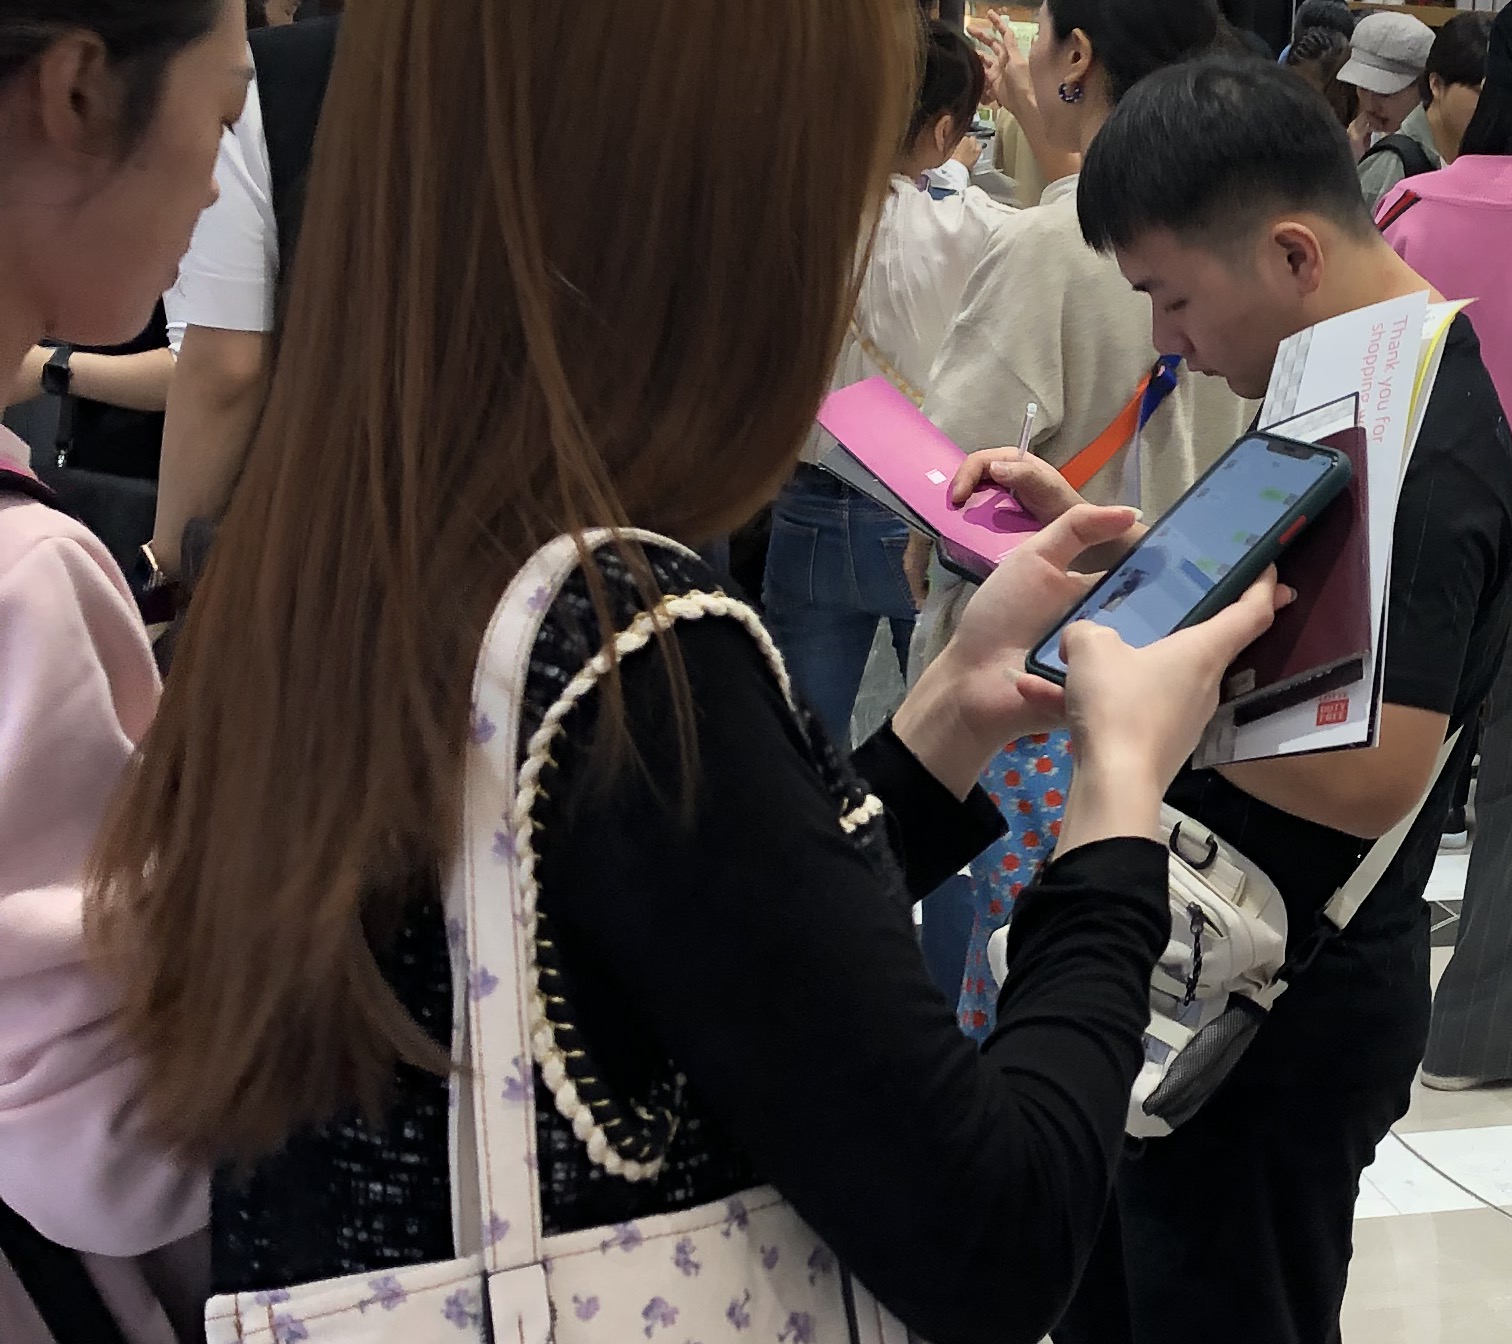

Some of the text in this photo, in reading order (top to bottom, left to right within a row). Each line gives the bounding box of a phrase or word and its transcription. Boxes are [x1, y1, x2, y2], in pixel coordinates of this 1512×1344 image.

[1372, 314, 1409, 444] Thank you for
